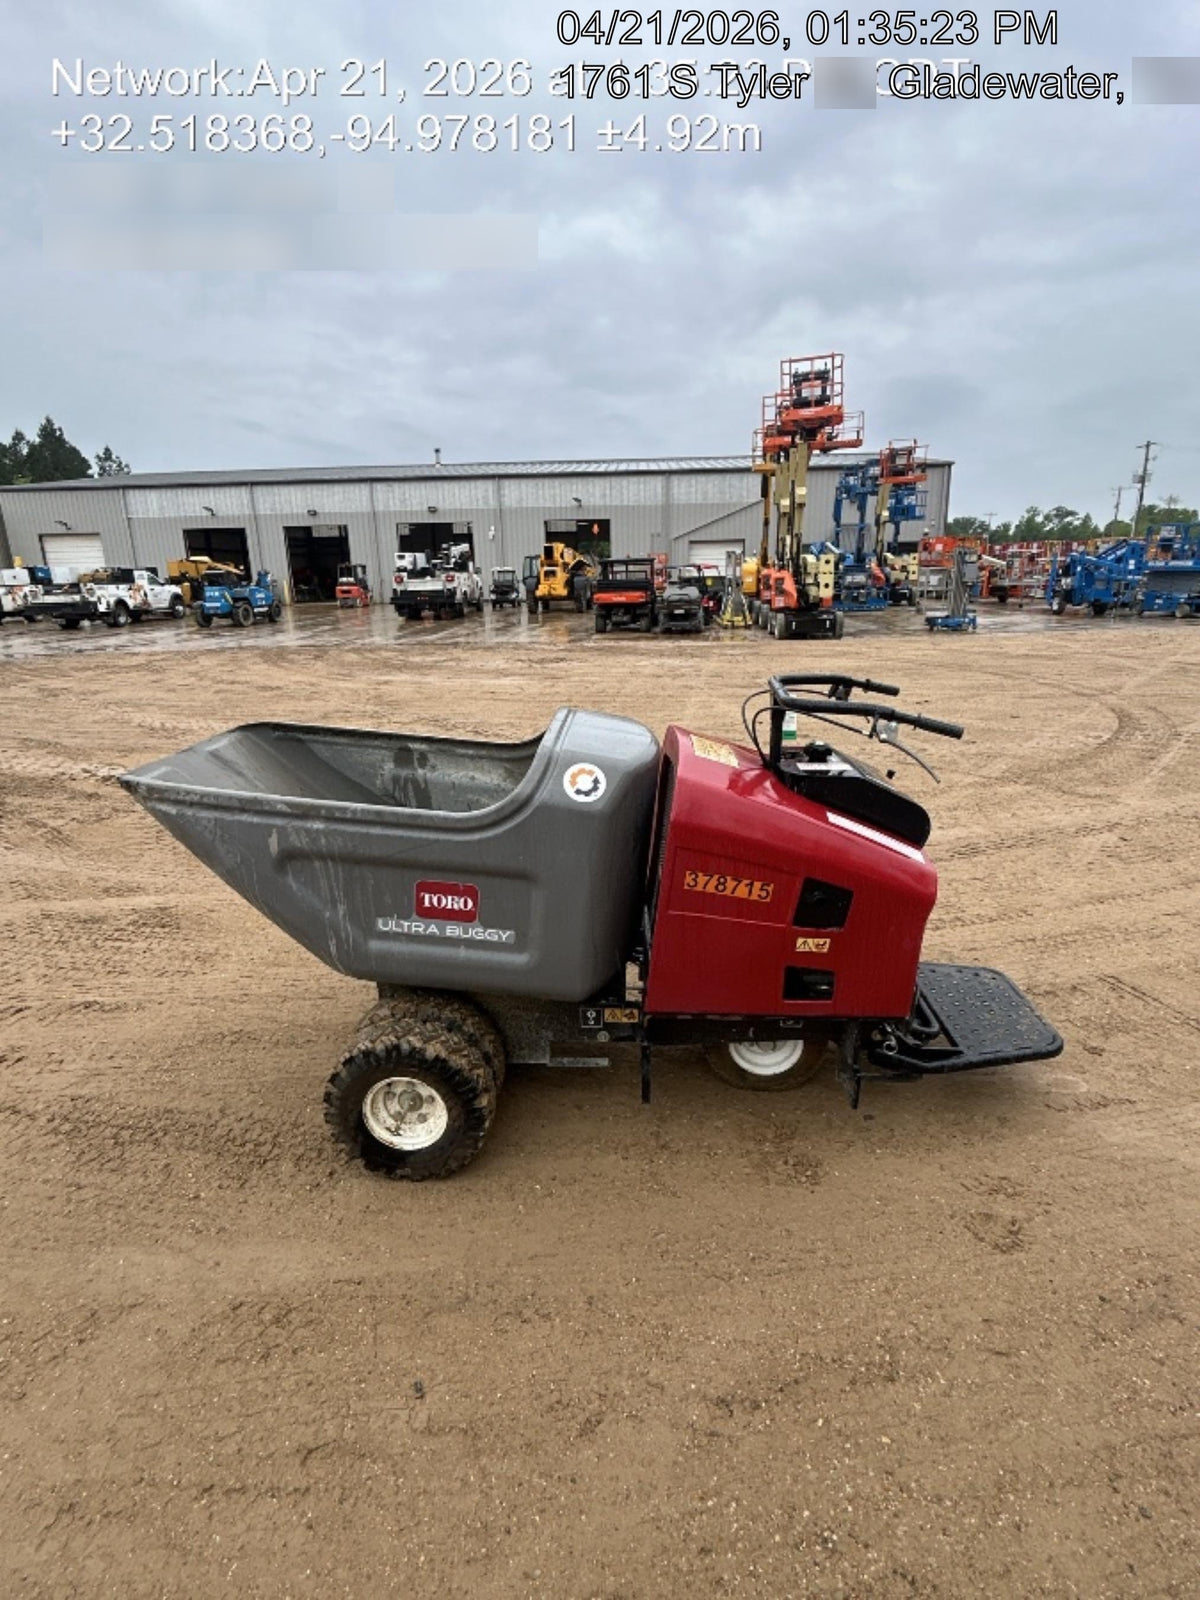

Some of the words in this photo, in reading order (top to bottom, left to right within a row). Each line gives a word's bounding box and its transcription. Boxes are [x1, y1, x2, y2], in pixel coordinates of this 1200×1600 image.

[686, 871, 771, 900] 378715
[420, 891, 474, 912] TORO
[377, 918, 440, 936] ULTRA
[445, 925, 513, 942] BUGGY
